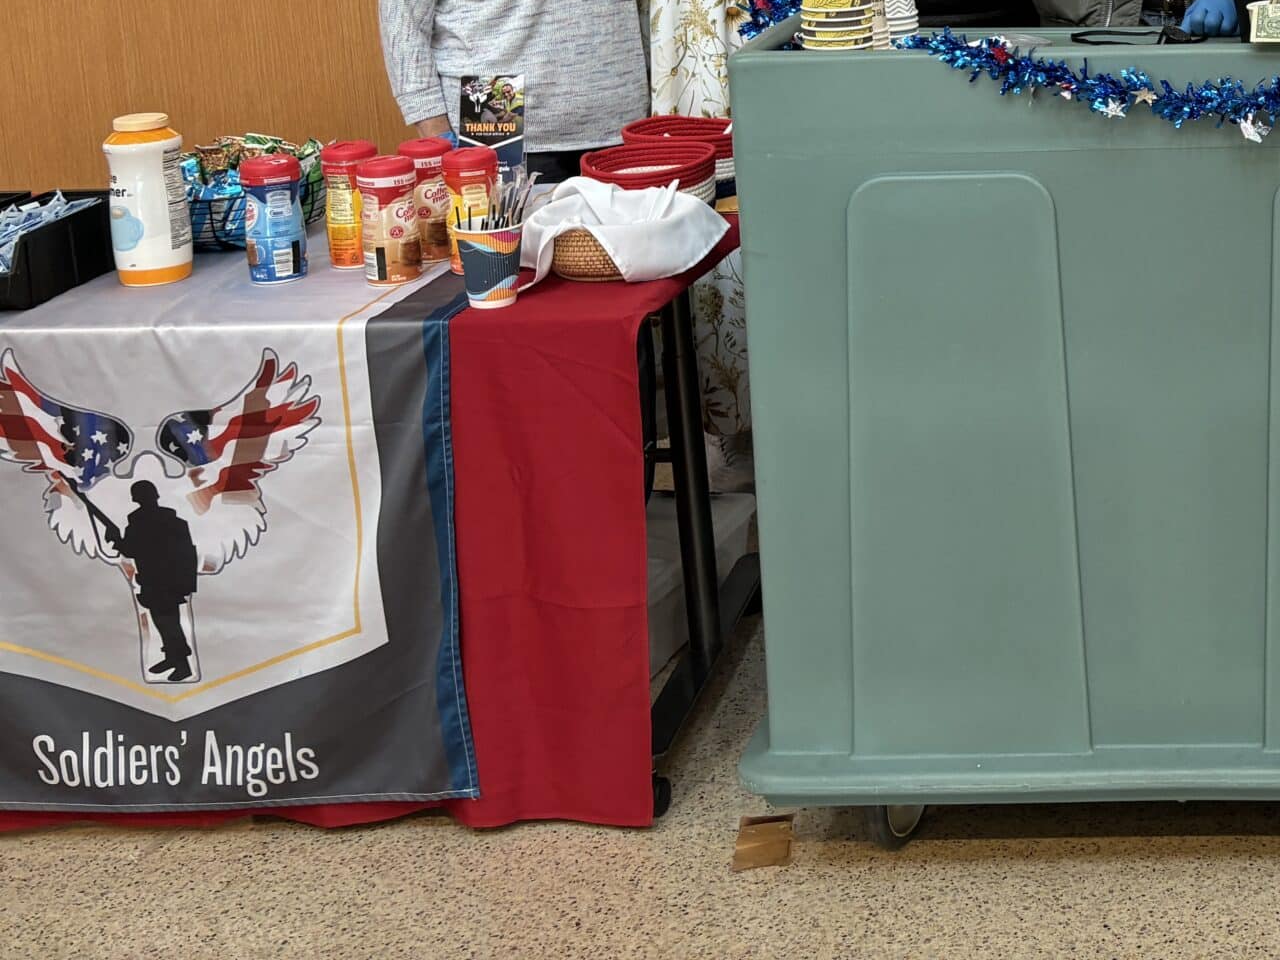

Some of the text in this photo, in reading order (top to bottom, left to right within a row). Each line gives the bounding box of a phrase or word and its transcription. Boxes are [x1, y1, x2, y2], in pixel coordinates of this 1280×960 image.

[465, 123, 516, 132] THANK YOU
[32, 729, 320, 798] Soldiers' Angels
